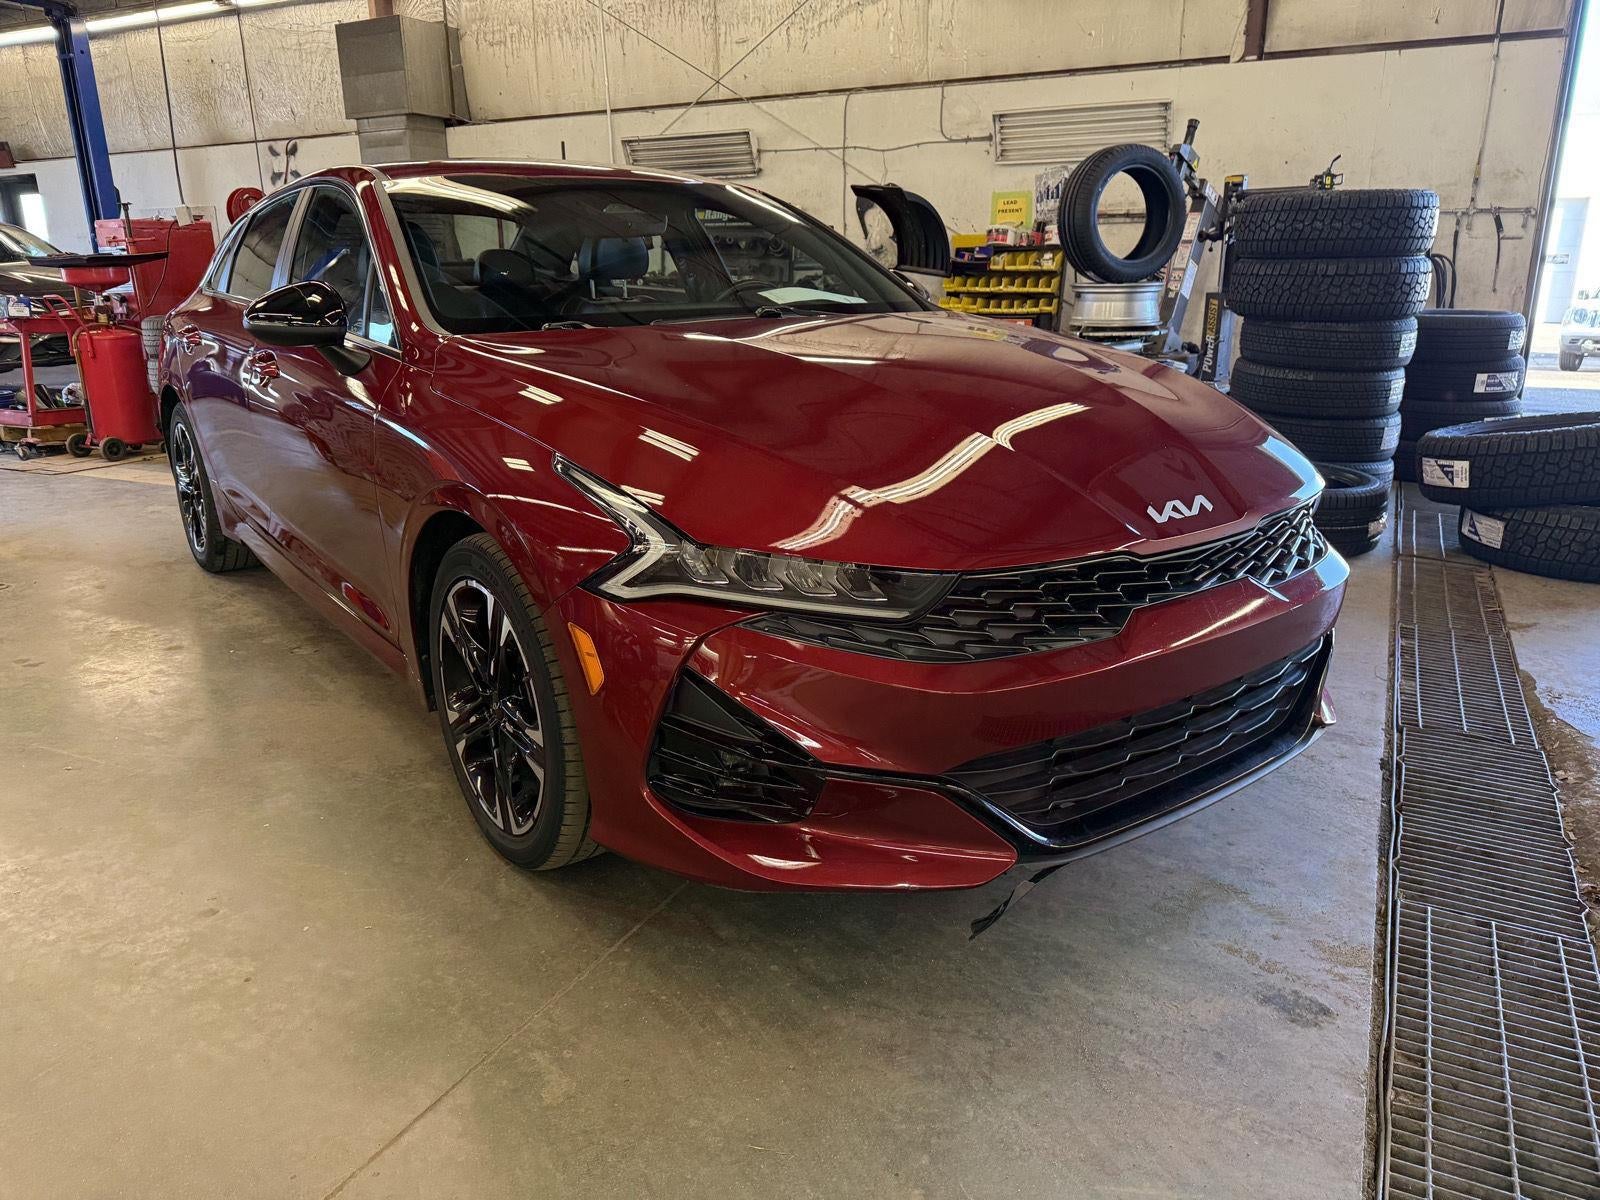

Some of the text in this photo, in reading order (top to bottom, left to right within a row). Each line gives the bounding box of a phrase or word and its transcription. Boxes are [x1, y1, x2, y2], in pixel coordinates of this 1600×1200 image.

[1202, 299, 1219, 374] POWER ASSIST
[1146, 494, 1214, 524] KIA
